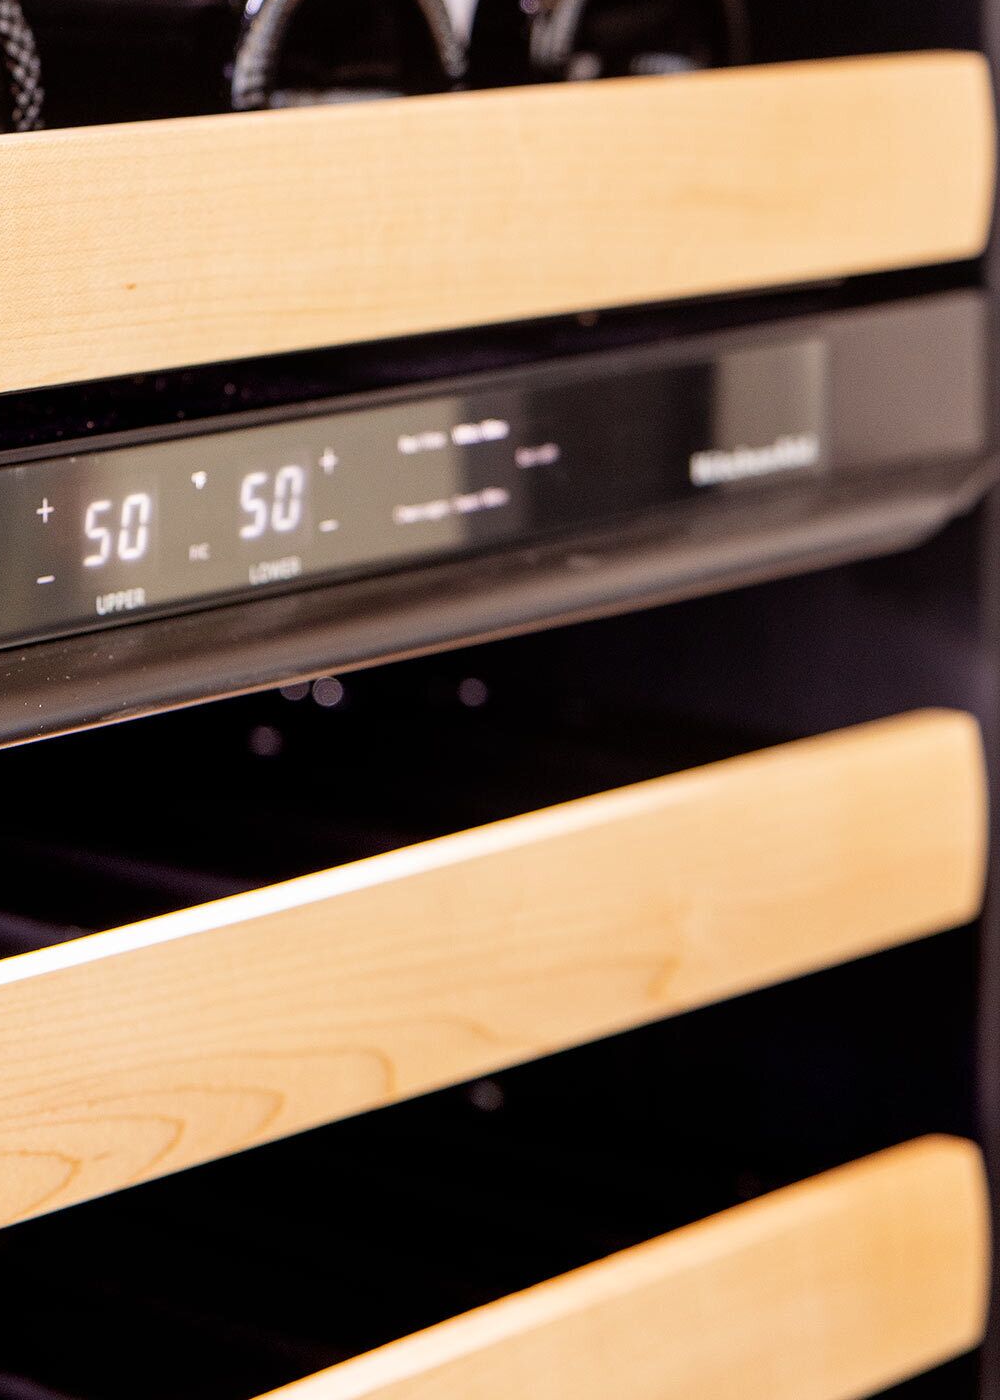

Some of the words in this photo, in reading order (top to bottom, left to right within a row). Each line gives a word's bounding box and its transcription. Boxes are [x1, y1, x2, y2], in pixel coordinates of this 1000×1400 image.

[240, 464, 304, 540] 50
[83, 492, 151, 567] 50
[248, 556, 302, 585] LOWER
[96, 587, 146, 614] UPPER
